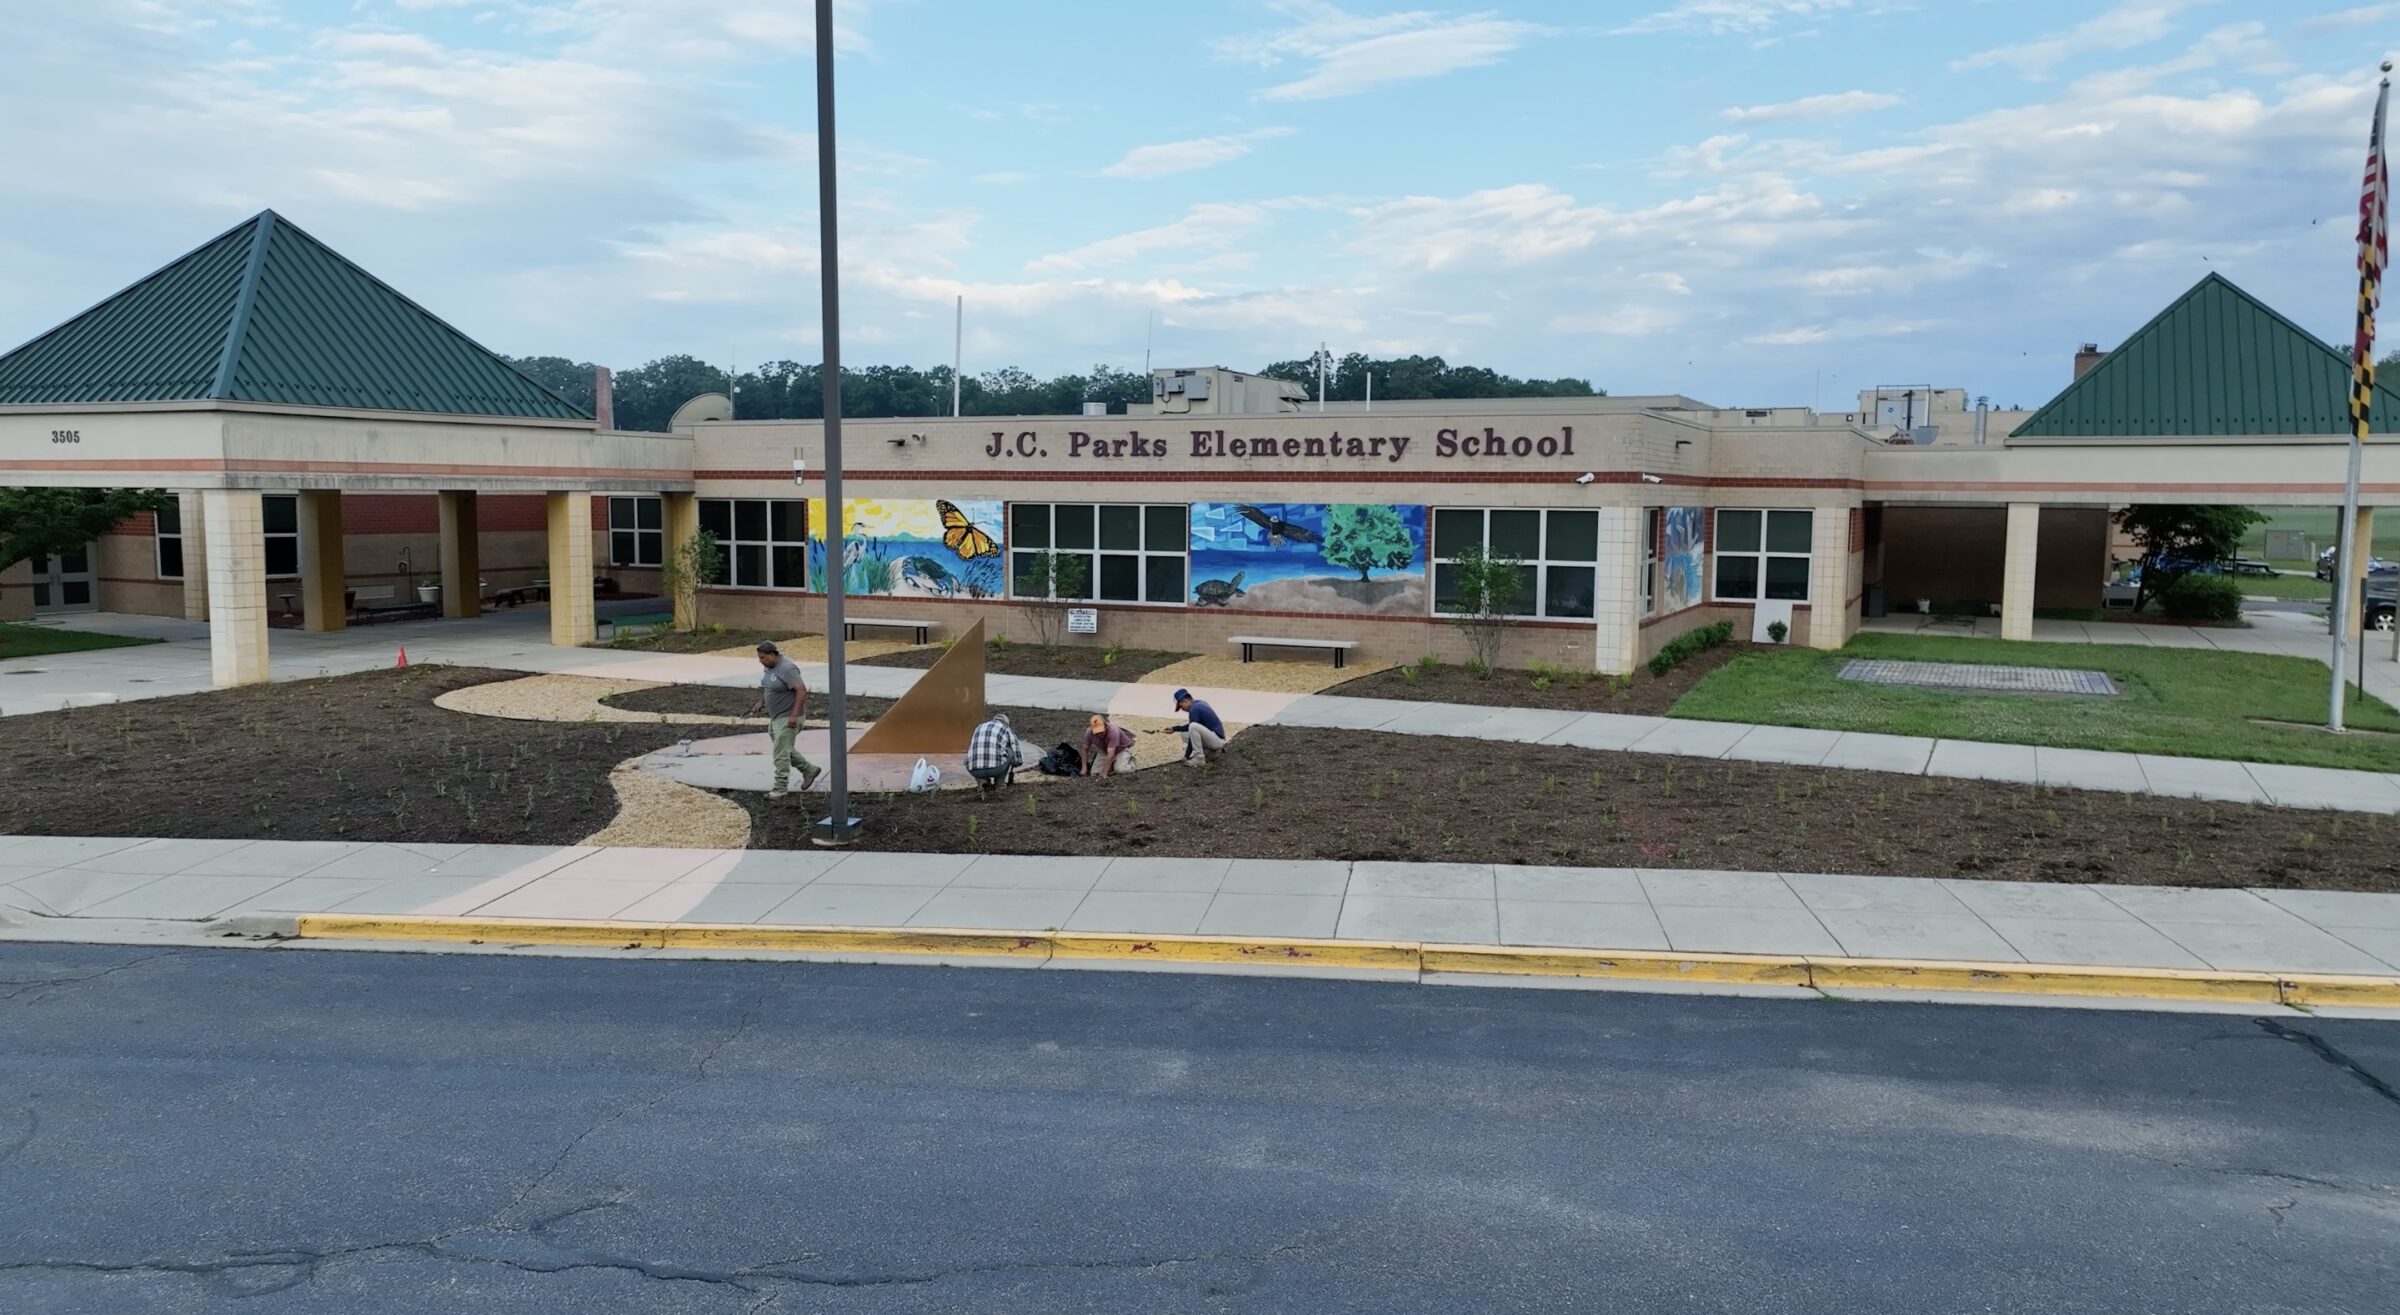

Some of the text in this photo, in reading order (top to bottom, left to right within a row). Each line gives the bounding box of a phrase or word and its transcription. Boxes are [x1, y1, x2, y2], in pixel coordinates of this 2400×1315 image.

[51, 430, 80, 444] 3505
[985, 426, 1575, 463] J.C. Parks Elementary School
